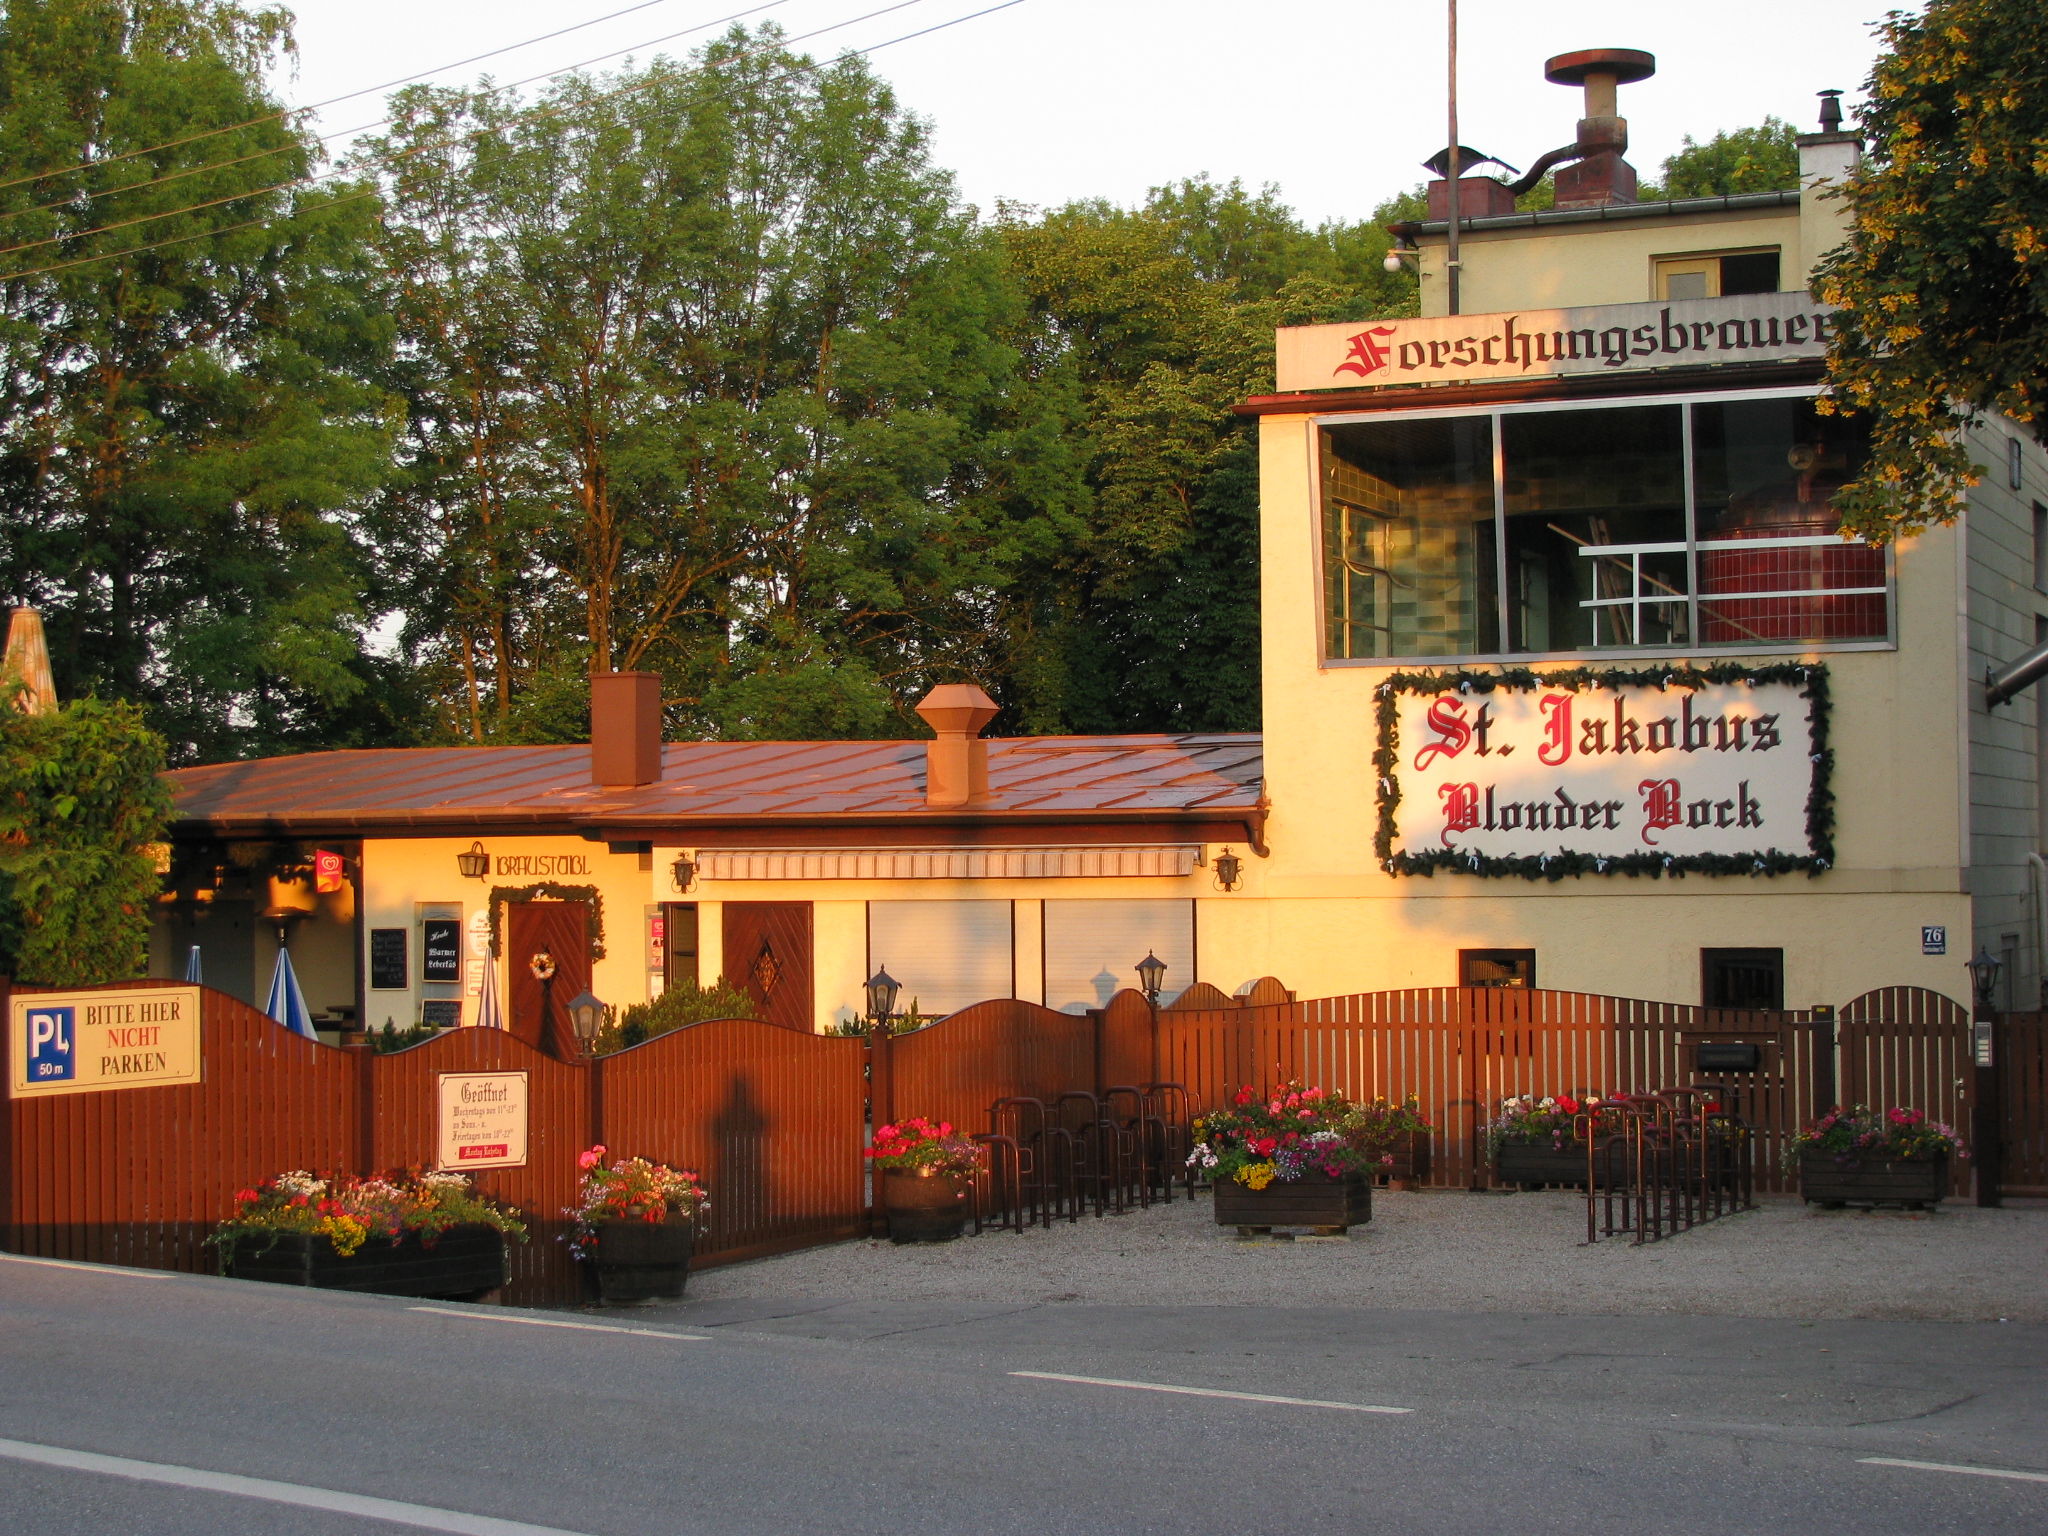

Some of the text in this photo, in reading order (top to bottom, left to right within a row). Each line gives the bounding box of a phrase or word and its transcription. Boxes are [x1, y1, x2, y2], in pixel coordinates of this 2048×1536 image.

[1333, 308, 1836, 377] Forschungsbrauer
[1414, 693, 1782, 771] St. Jakobus
[1438, 778, 1764, 848] Blonder Bock
[1924, 928, 1943, 942] 76
[428, 948, 457, 957] Warmer
[86, 1001, 181, 1026] BITTE HIER
[108, 1026, 161, 1049] NICHT
[39, 1063, 64, 1075] 50 m
[100, 1052, 167, 1076] PARKEN
[461, 1082, 507, 1103] Geöffnet
